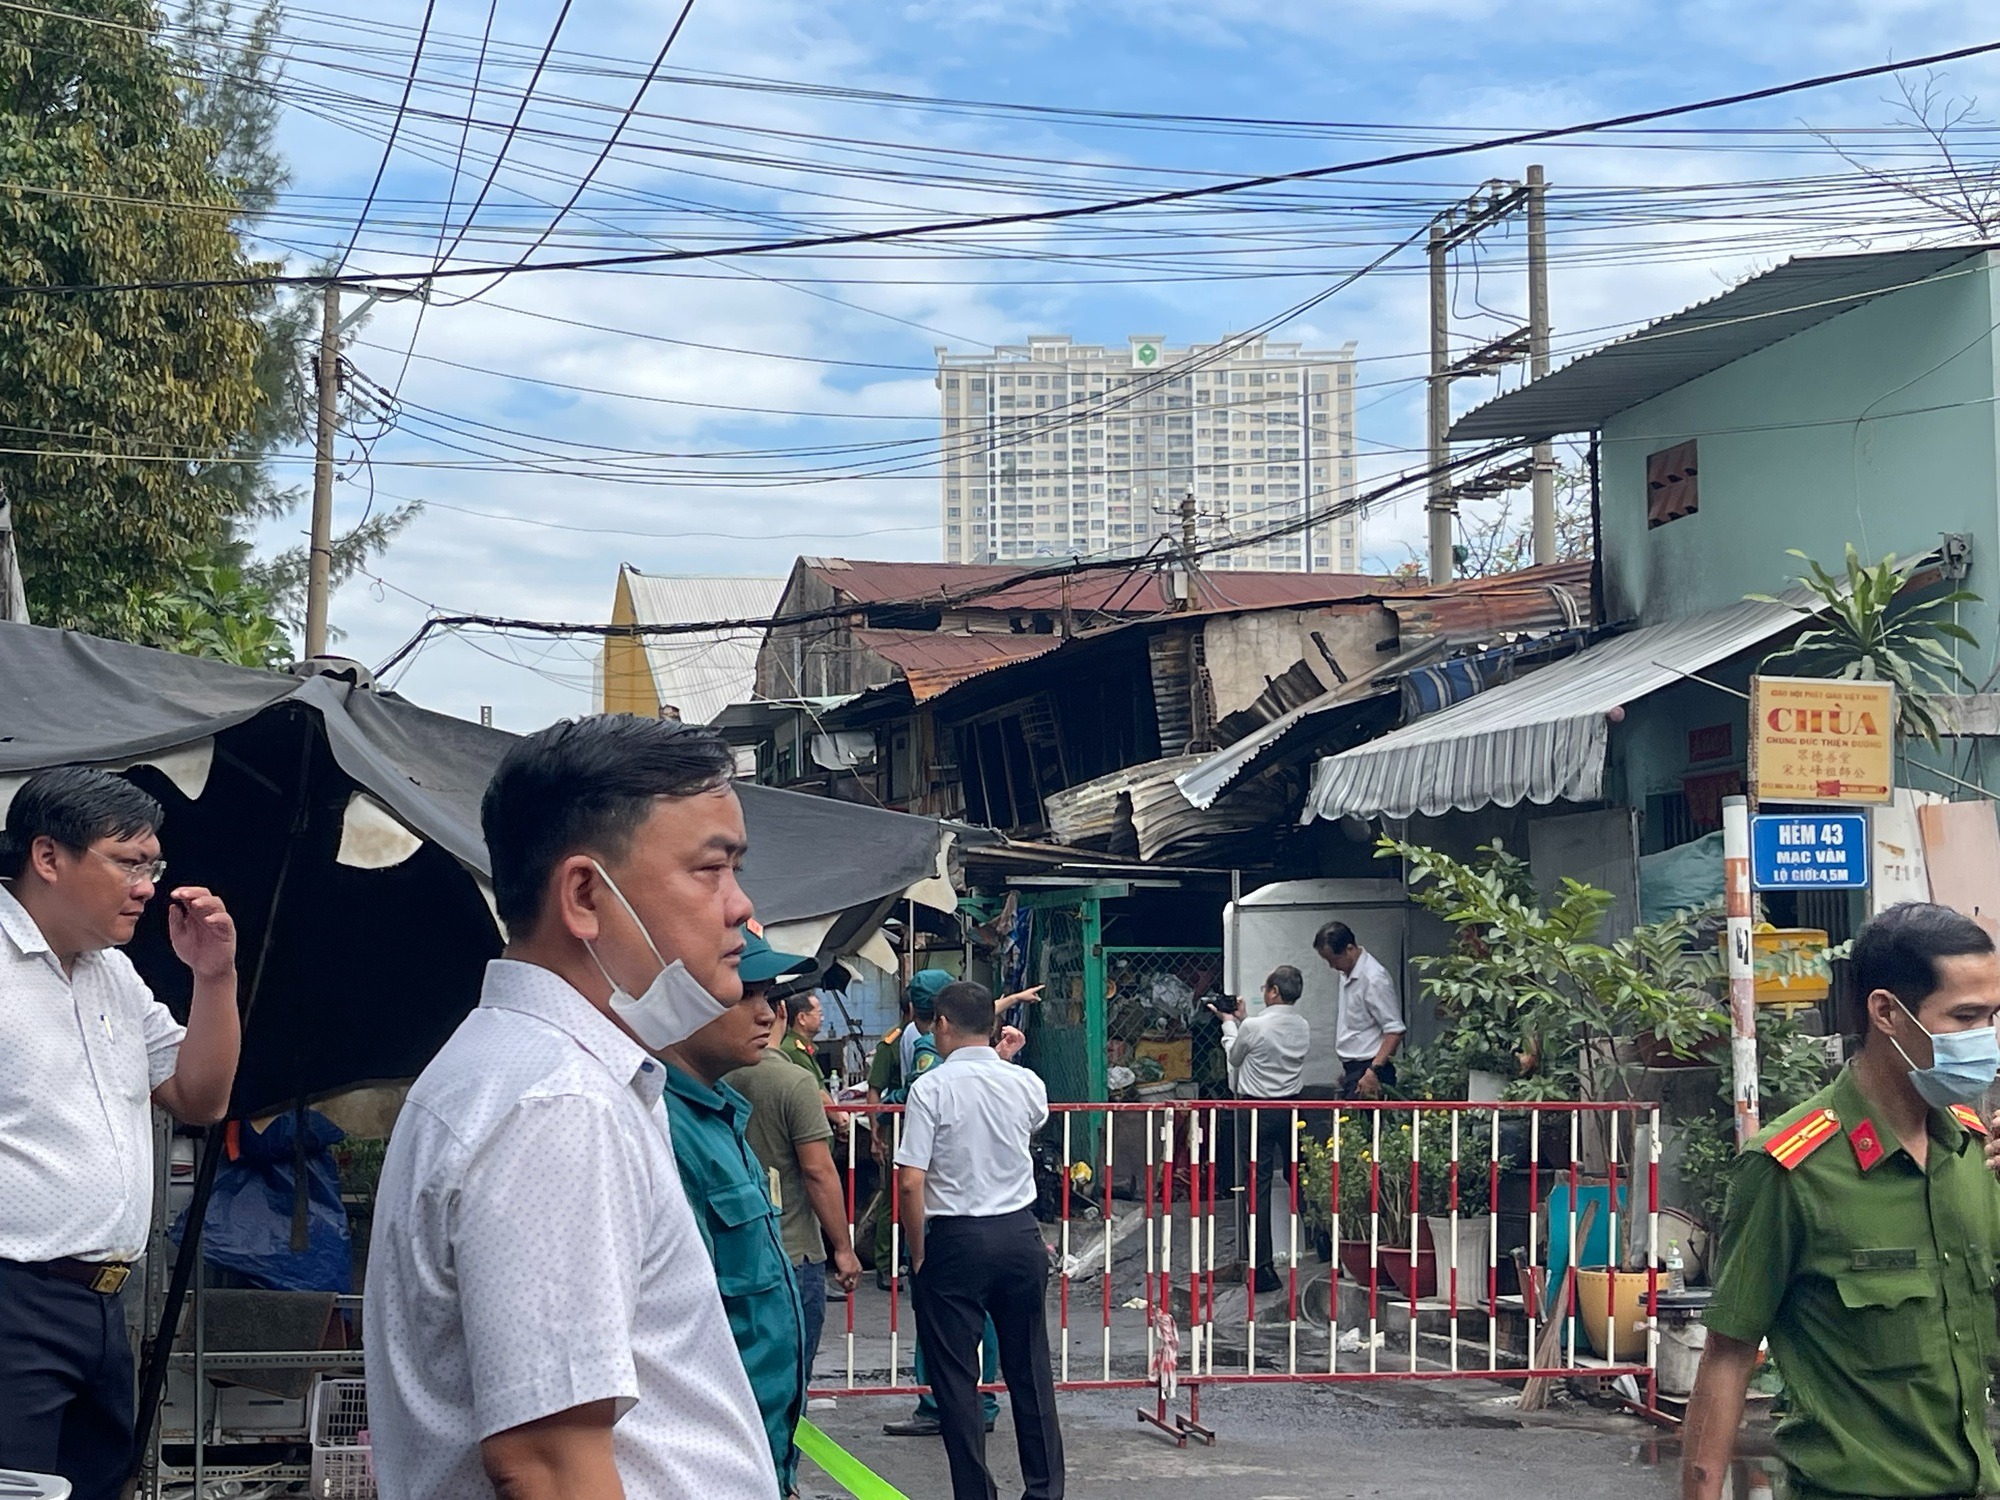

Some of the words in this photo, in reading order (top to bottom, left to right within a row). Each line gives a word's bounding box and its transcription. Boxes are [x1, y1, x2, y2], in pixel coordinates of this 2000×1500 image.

[1767, 703, 1879, 735] CHÙA
[1779, 819, 1816, 845] HẺM
[1820, 823, 1844, 845] 43
[1776, 851, 1812, 866] MẠC
[1815, 847, 1847, 863] VÂN
[1773, 867, 1788, 883] LỘ
